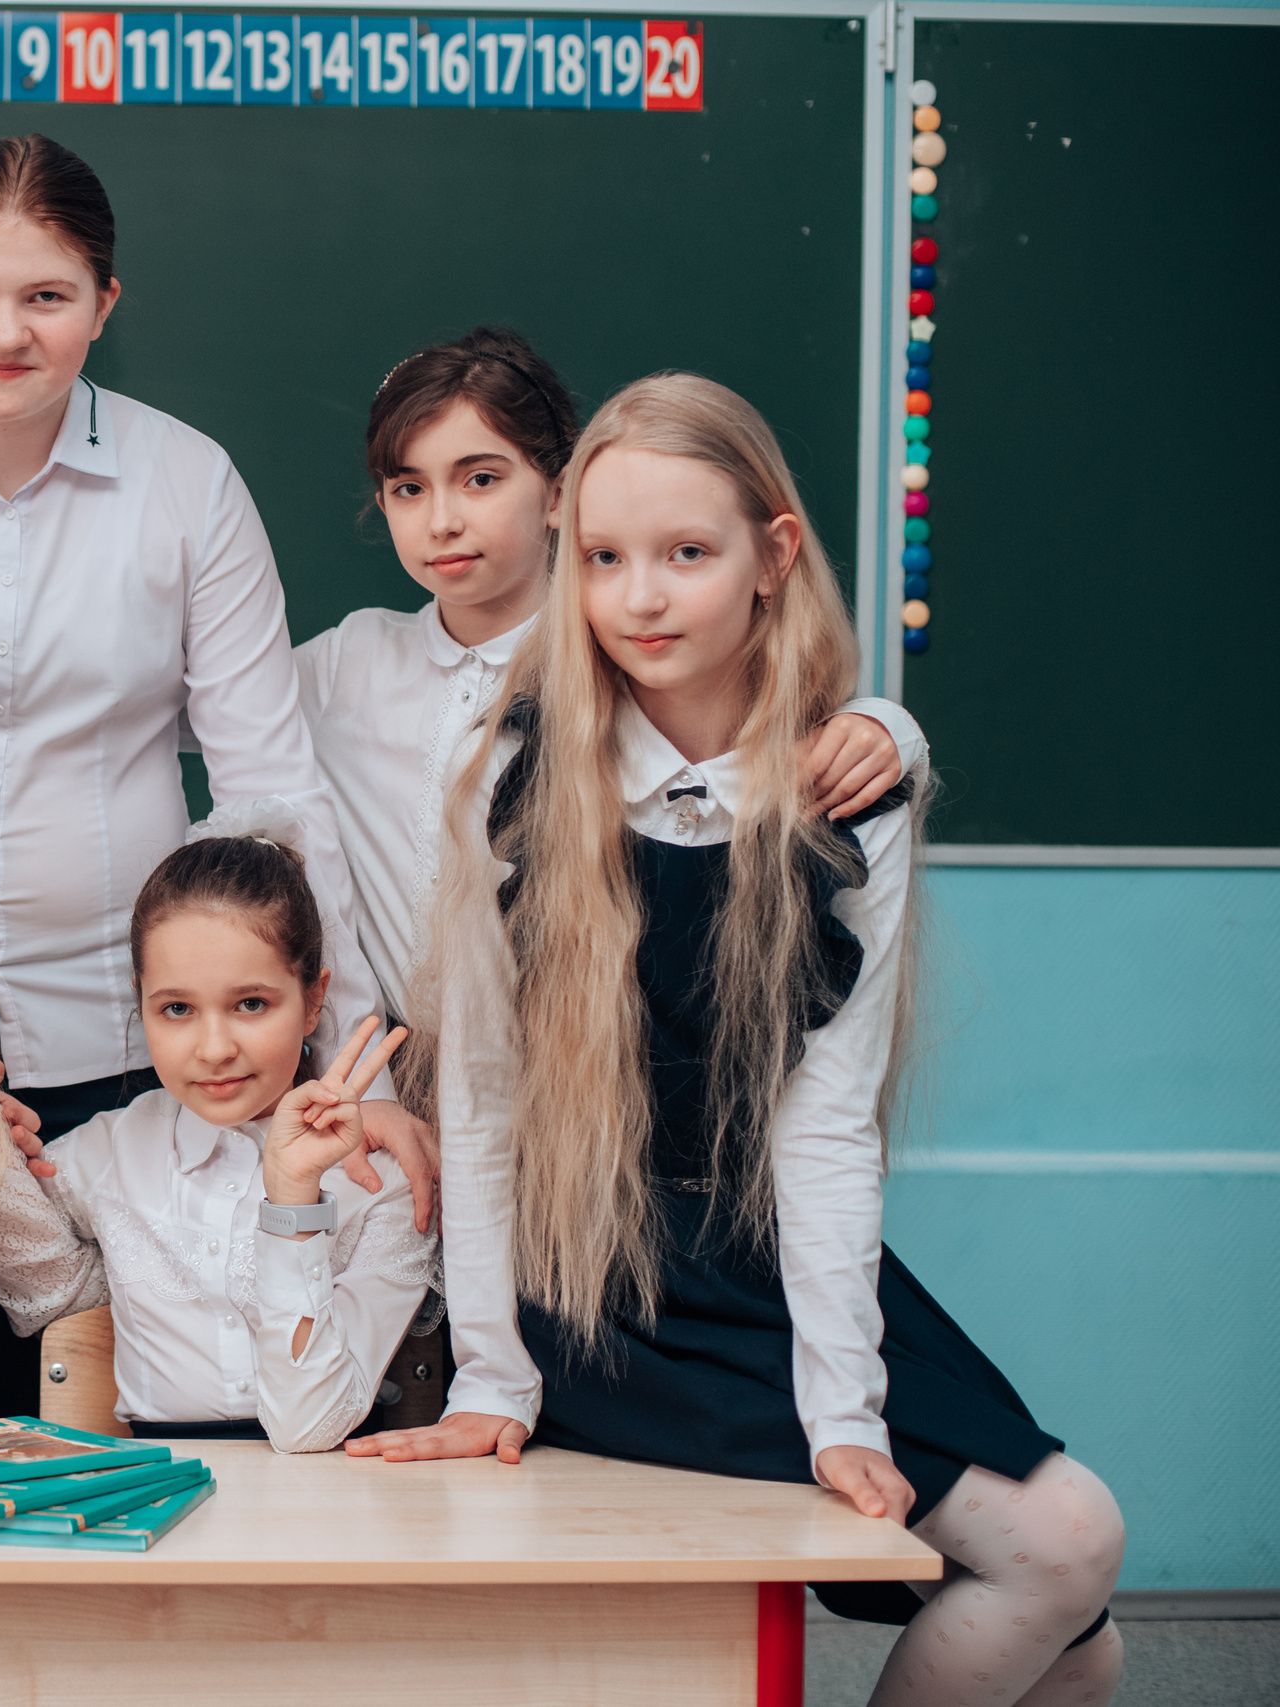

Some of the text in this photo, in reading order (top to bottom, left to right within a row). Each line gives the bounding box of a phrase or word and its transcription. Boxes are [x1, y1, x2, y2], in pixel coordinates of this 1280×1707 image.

[18, 26, 50, 86] 9
[65, 27, 115, 89] 10
[125, 29, 170, 90] 11
[183, 29, 233, 90] 12
[242, 30, 291, 91] 13
[301, 32, 352, 92] 14
[360, 32, 409, 93] 15
[419, 33, 470, 94] 16
[477, 33, 526, 94] 17
[534, 34, 585, 95] 18
[592, 35, 642, 96] 19
[648, 36, 700, 98] 20
